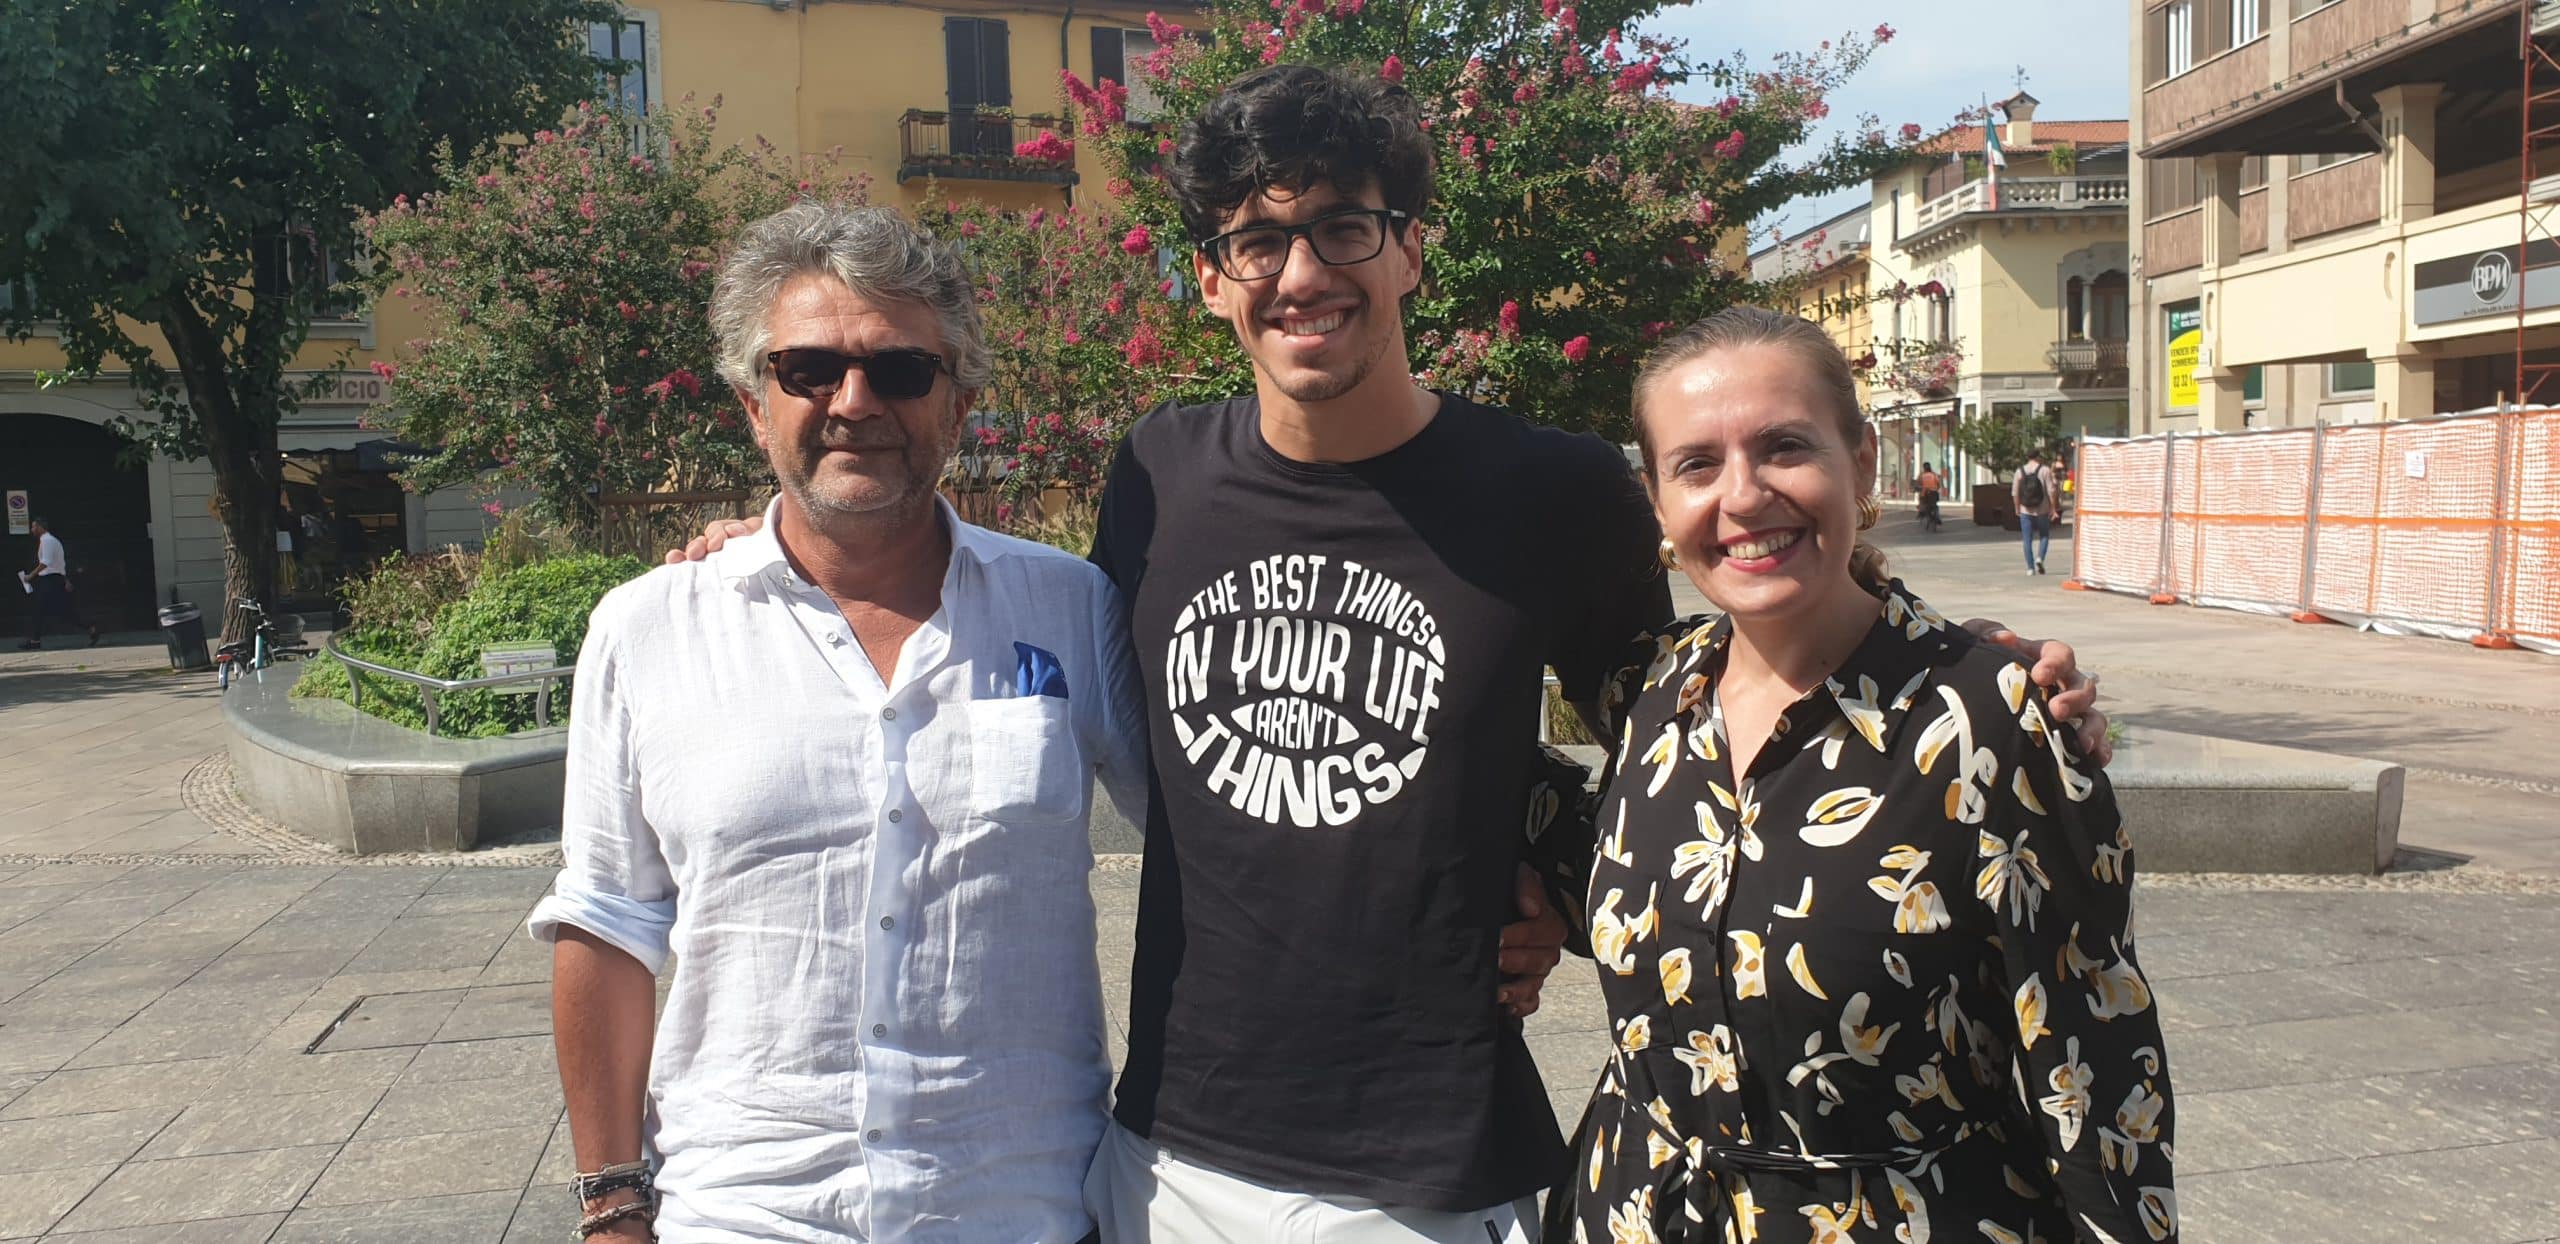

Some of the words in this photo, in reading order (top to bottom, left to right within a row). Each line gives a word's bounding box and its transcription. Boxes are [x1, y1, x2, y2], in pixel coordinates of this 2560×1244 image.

[2475, 262, 2507, 292] BPM
[1192, 571, 1241, 619] THE
[1250, 554, 1326, 611] BEST
[1335, 561, 1435, 645] THINGS
[1165, 625, 1214, 711] IN
[1231, 616, 1350, 702] YOUR
[1365, 636, 1444, 746] LIFE
[1256, 697, 1336, 749] AREN'T
[1187, 714, 1403, 828] THINGS
